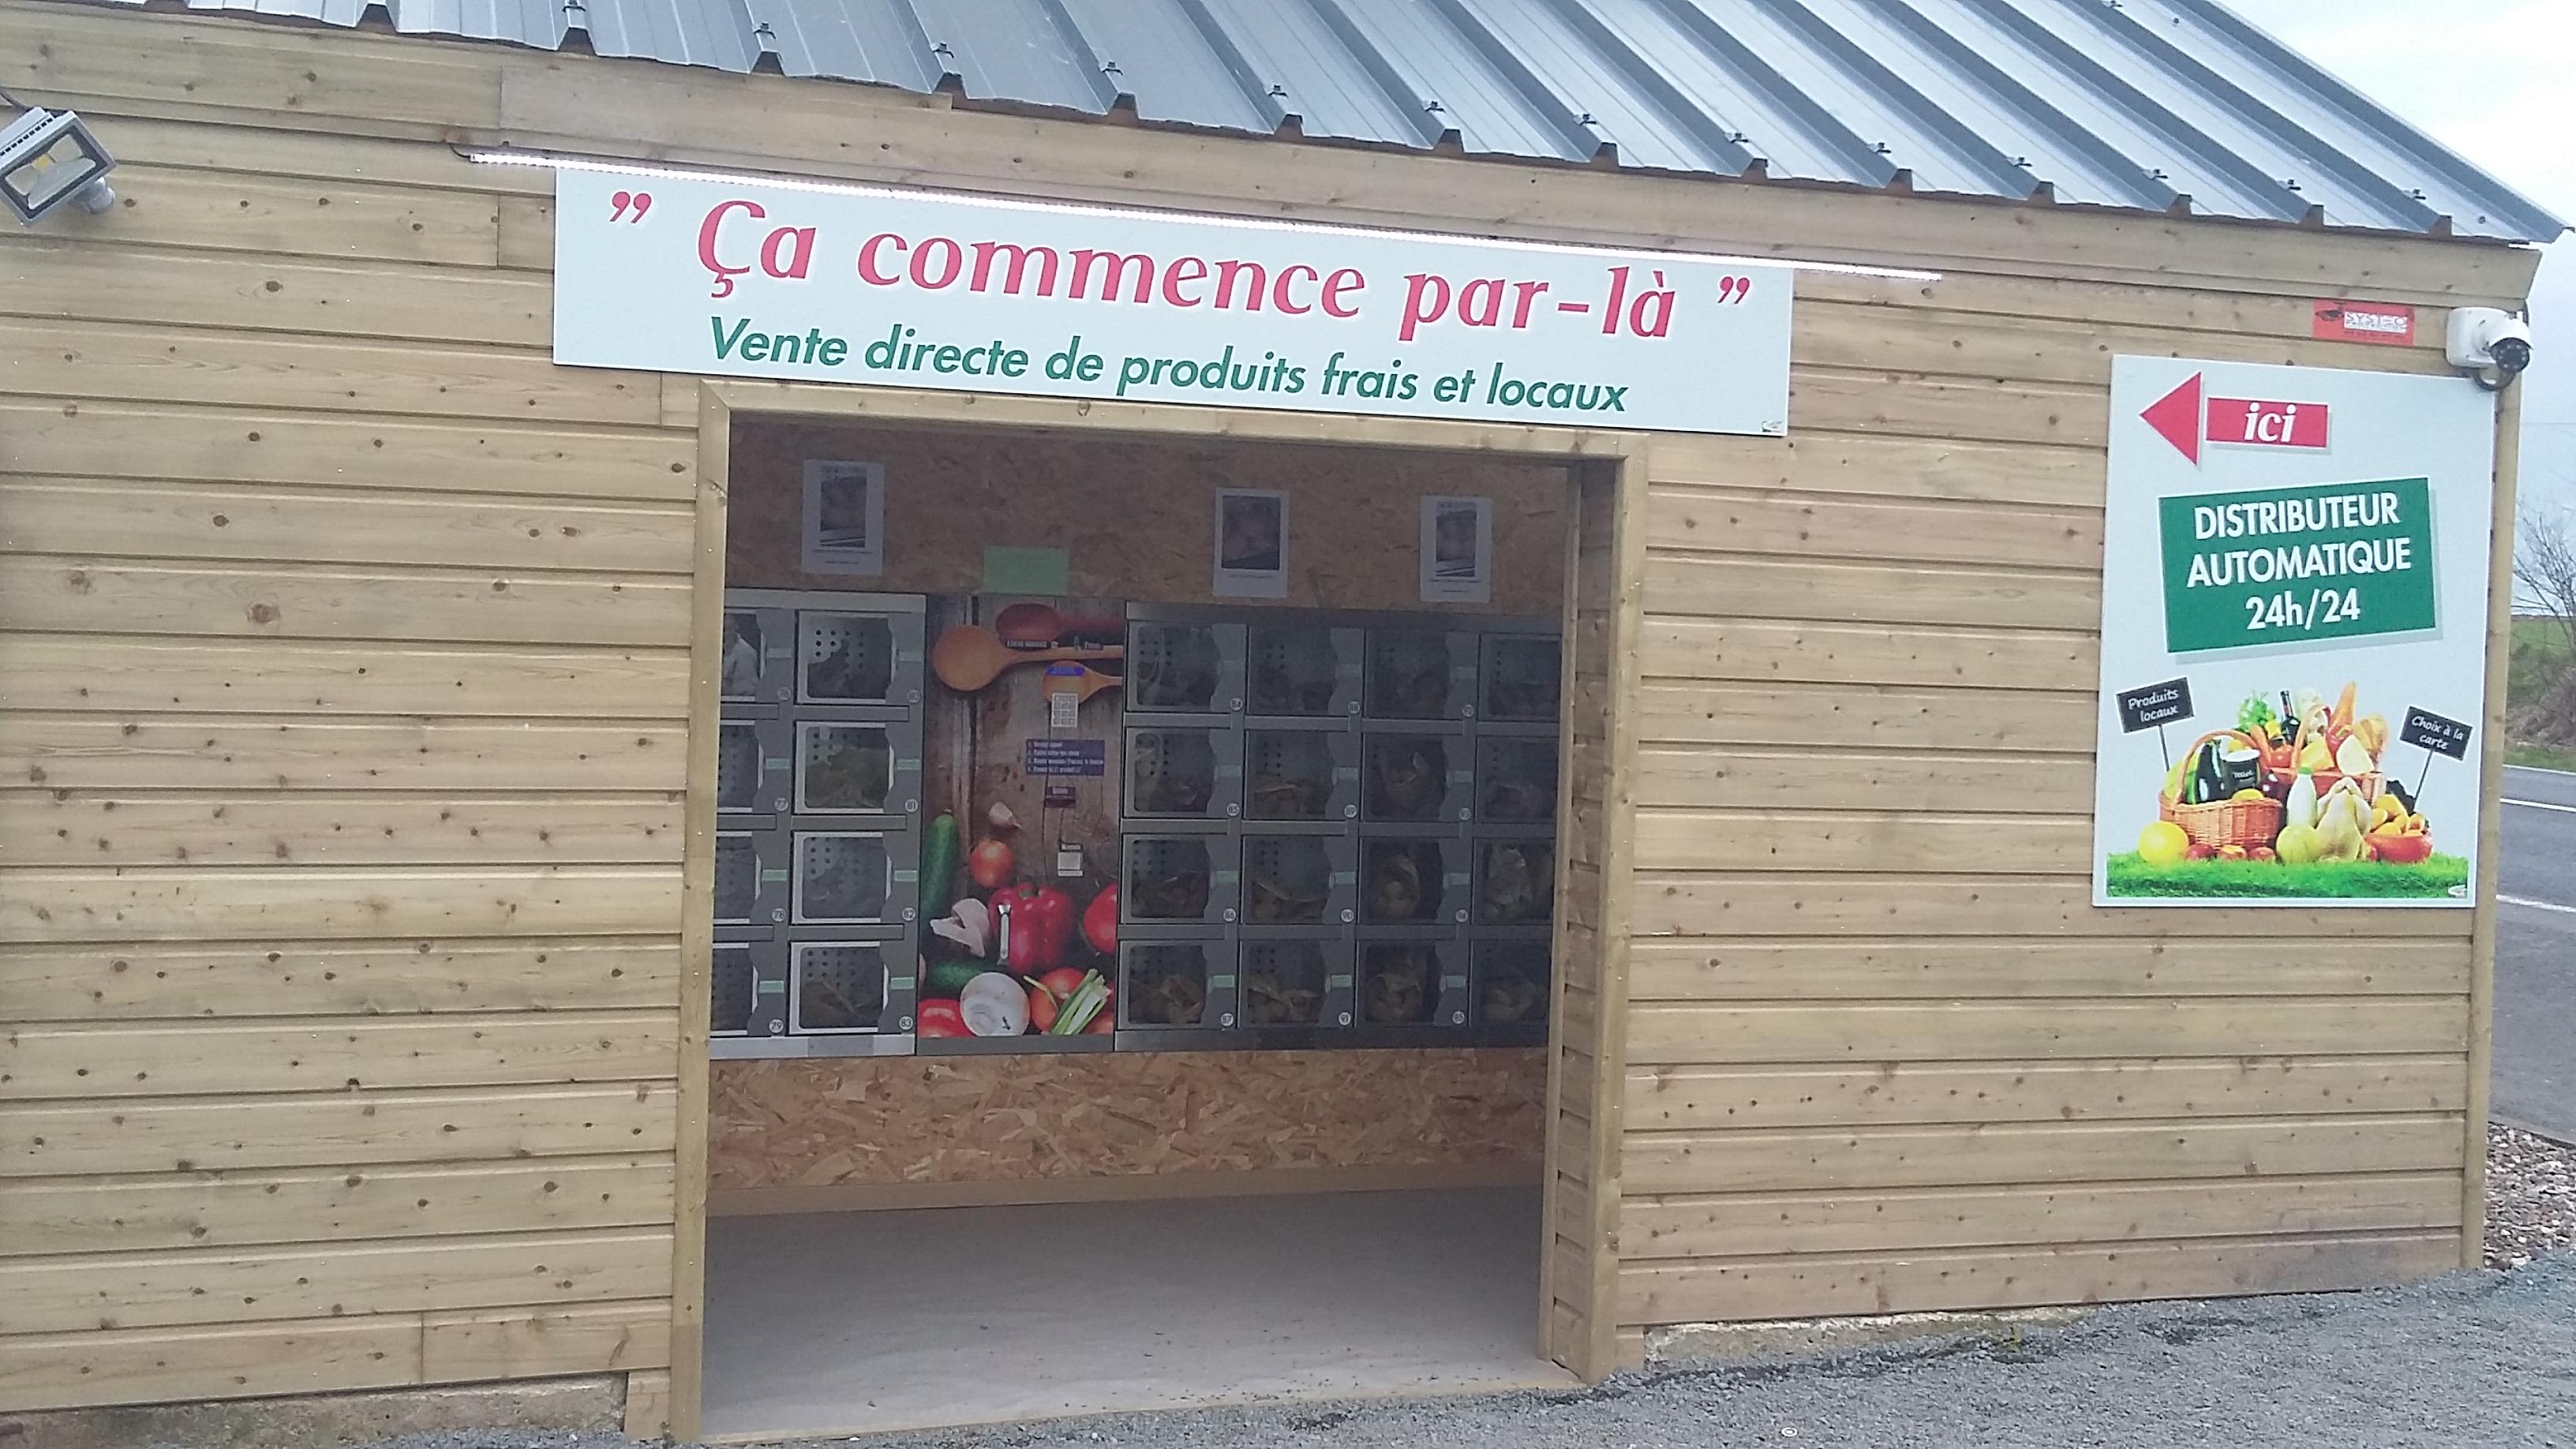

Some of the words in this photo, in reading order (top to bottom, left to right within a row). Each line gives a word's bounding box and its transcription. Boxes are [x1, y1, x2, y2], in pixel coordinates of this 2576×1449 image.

[698, 200, 816, 298] Ça
[857, 234, 1365, 318] commence
[711, 317, 848, 366] Vente
[865, 324, 1028, 377] directe
[1045, 335, 1104, 381] de
[1116, 345, 1305, 396] produits
[1322, 352, 1417, 400] frais
[1433, 369, 1476, 402] et
[1488, 362, 1629, 411] locaux
[2244, 402, 2297, 443] ici
[2194, 492, 2400, 540] DISTRIBUTEUR
[2187, 537, 2411, 588] AUTOMATIQUE
[2245, 588, 2361, 631] 24h/24
[2128, 688, 2179, 710] Produits
[2140, 705, 2178, 722] locaux
[2411, 715, 2443, 733] Choix
[2443, 724, 2451, 736] à
[2453, 728, 2464, 740] la
[2419, 734, 2449, 750] carte
